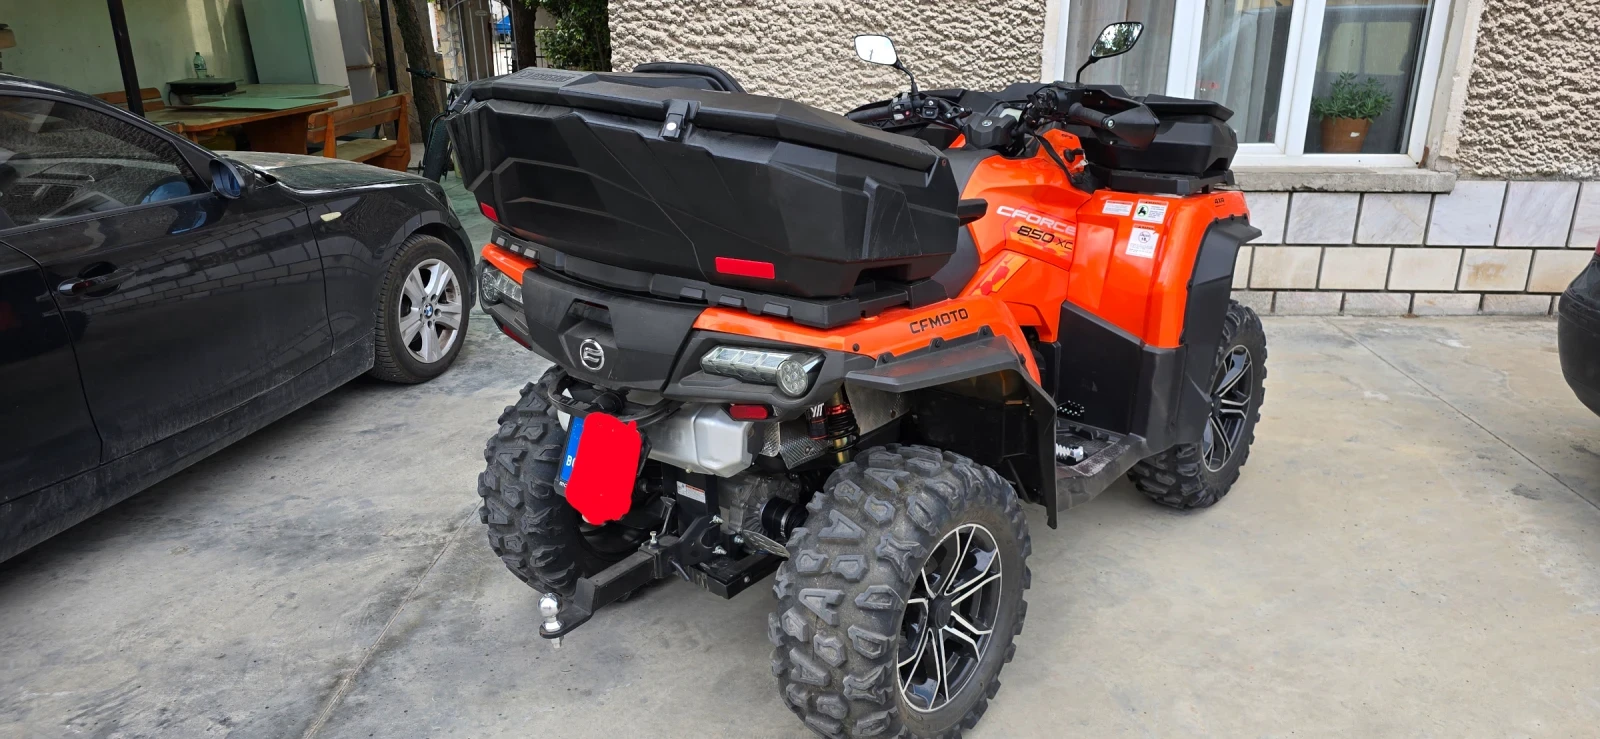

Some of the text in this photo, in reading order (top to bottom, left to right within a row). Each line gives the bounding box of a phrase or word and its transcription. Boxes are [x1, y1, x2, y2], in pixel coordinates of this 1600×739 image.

[996, 205, 1077, 237] CFORCE
[1017, 225, 1073, 250] 850 XC
[909, 308, 968, 334] CFMOTO
